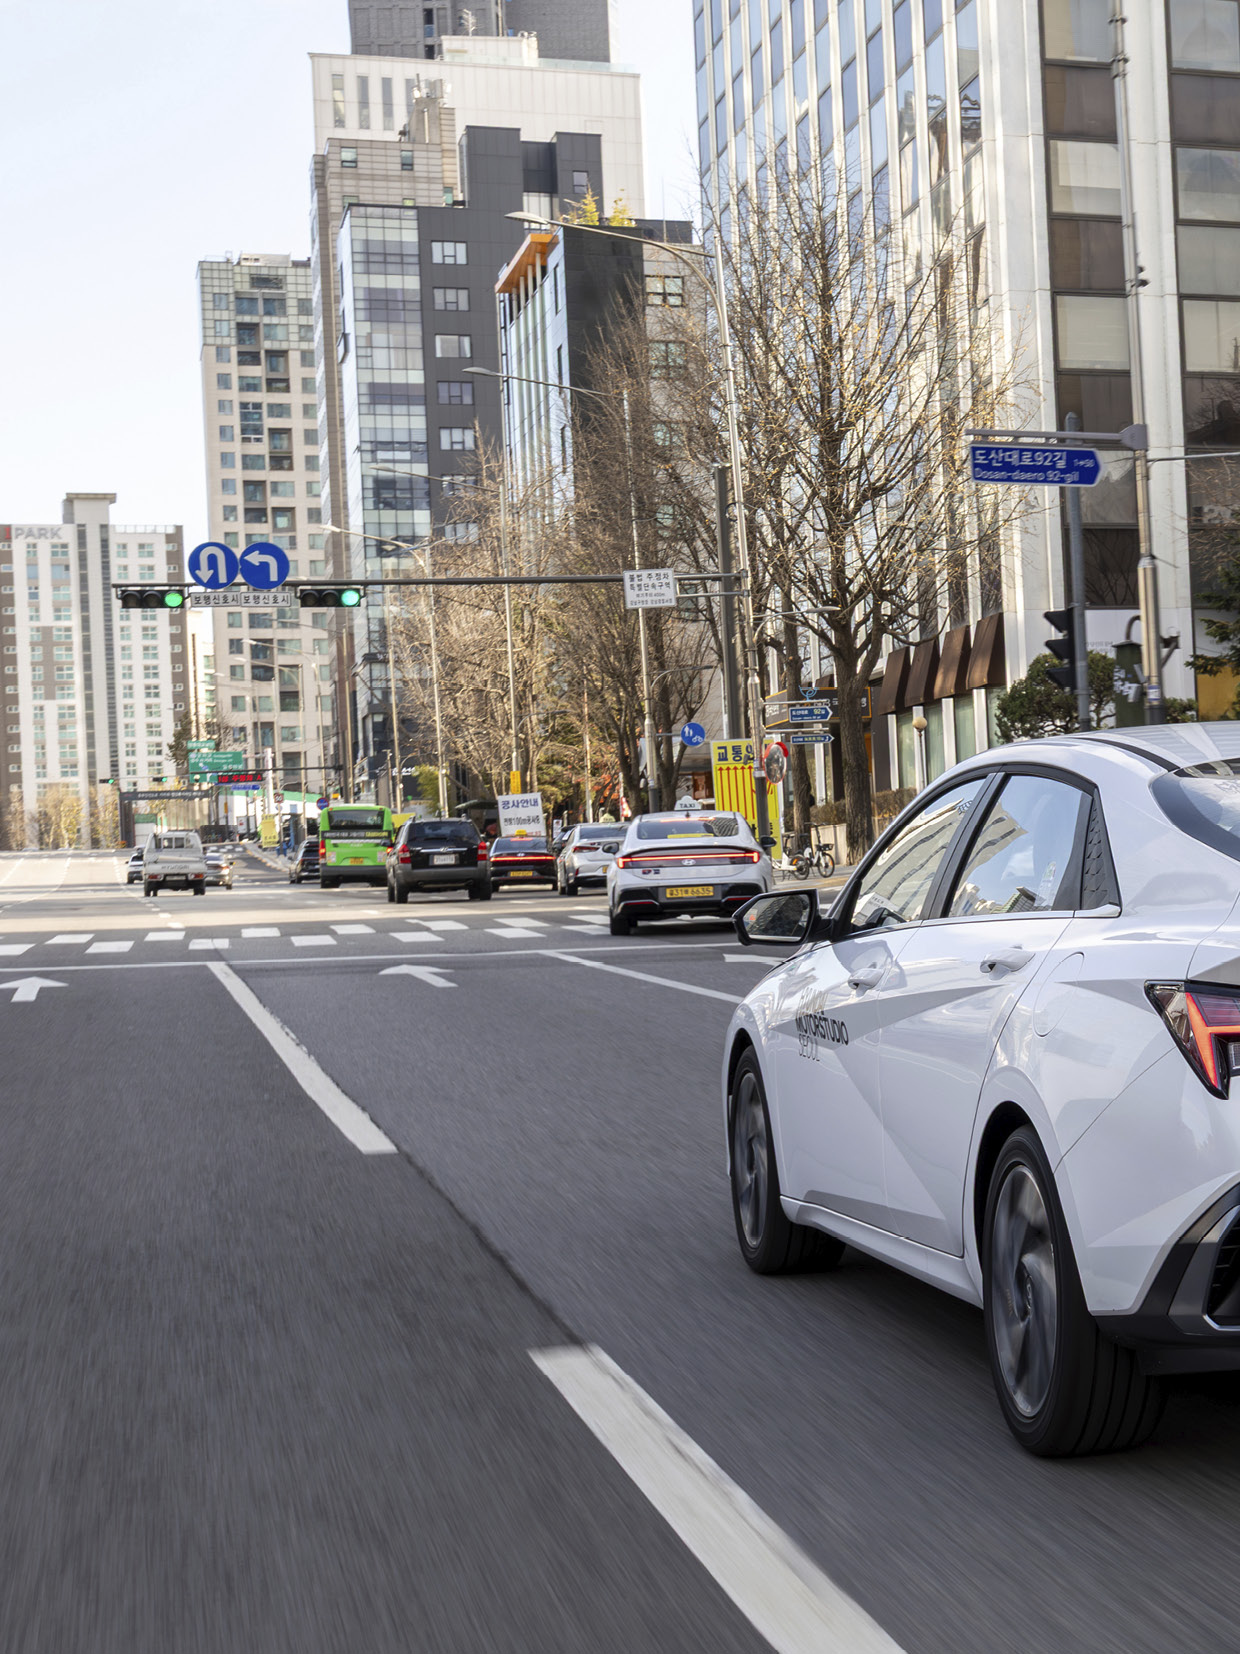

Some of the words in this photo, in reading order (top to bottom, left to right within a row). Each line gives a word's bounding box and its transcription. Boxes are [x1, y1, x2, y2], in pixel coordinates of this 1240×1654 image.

[974, 449, 1067, 469] 도산대로92길
[974, 468, 1045, 481] Dosan-daero
[194, 594, 239, 605] 보행신호시
[243, 594, 290, 604] 보행신호시
[501, 797, 540, 810] 공사안내
